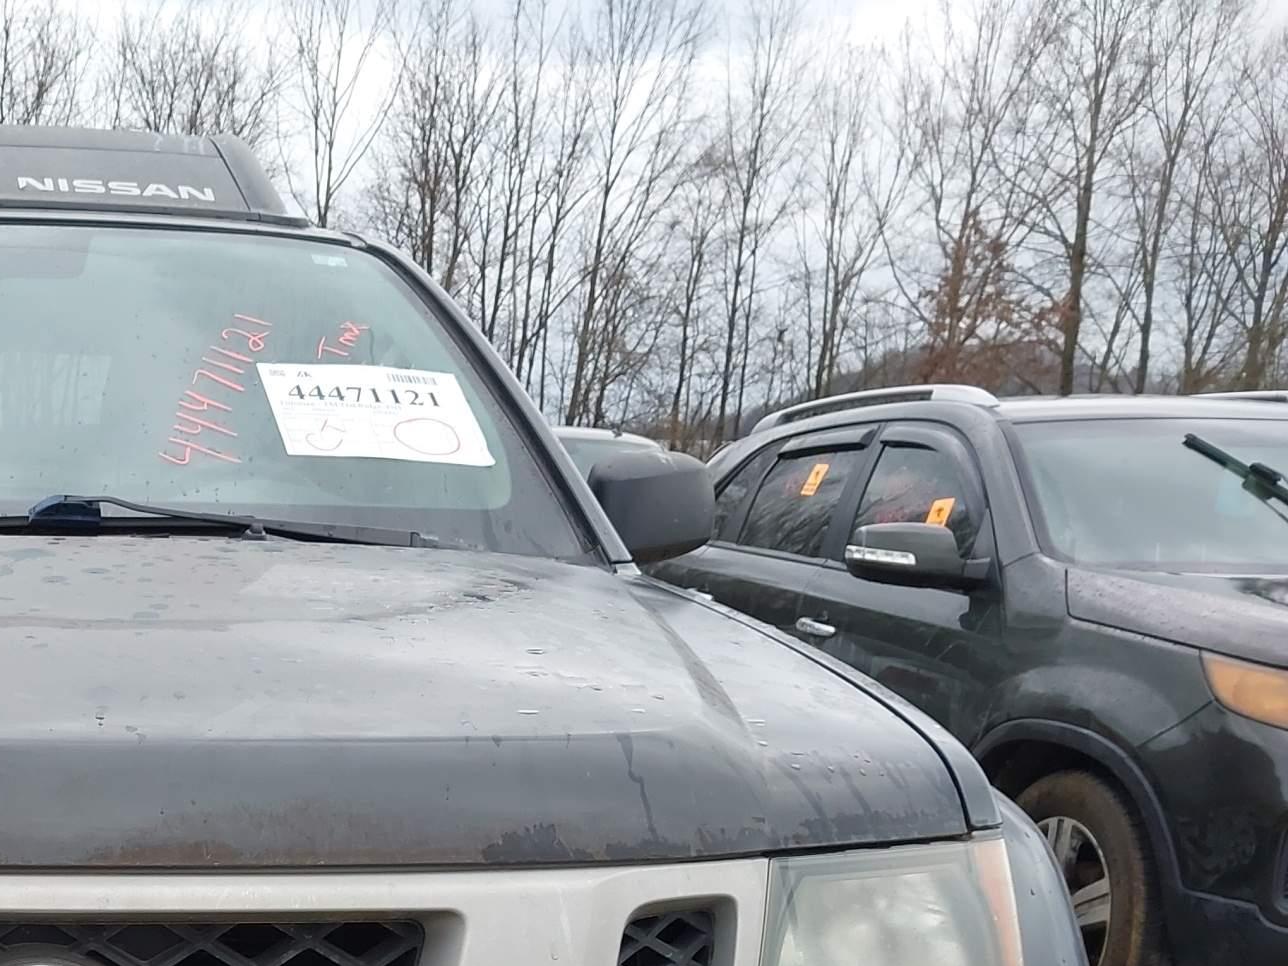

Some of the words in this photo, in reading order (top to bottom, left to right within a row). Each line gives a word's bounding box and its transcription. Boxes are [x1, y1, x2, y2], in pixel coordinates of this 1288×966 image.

[17, 176, 215, 201] NISSAN
[158, 313, 273, 465] 44471121
[287, 383, 440, 407] 44471121
